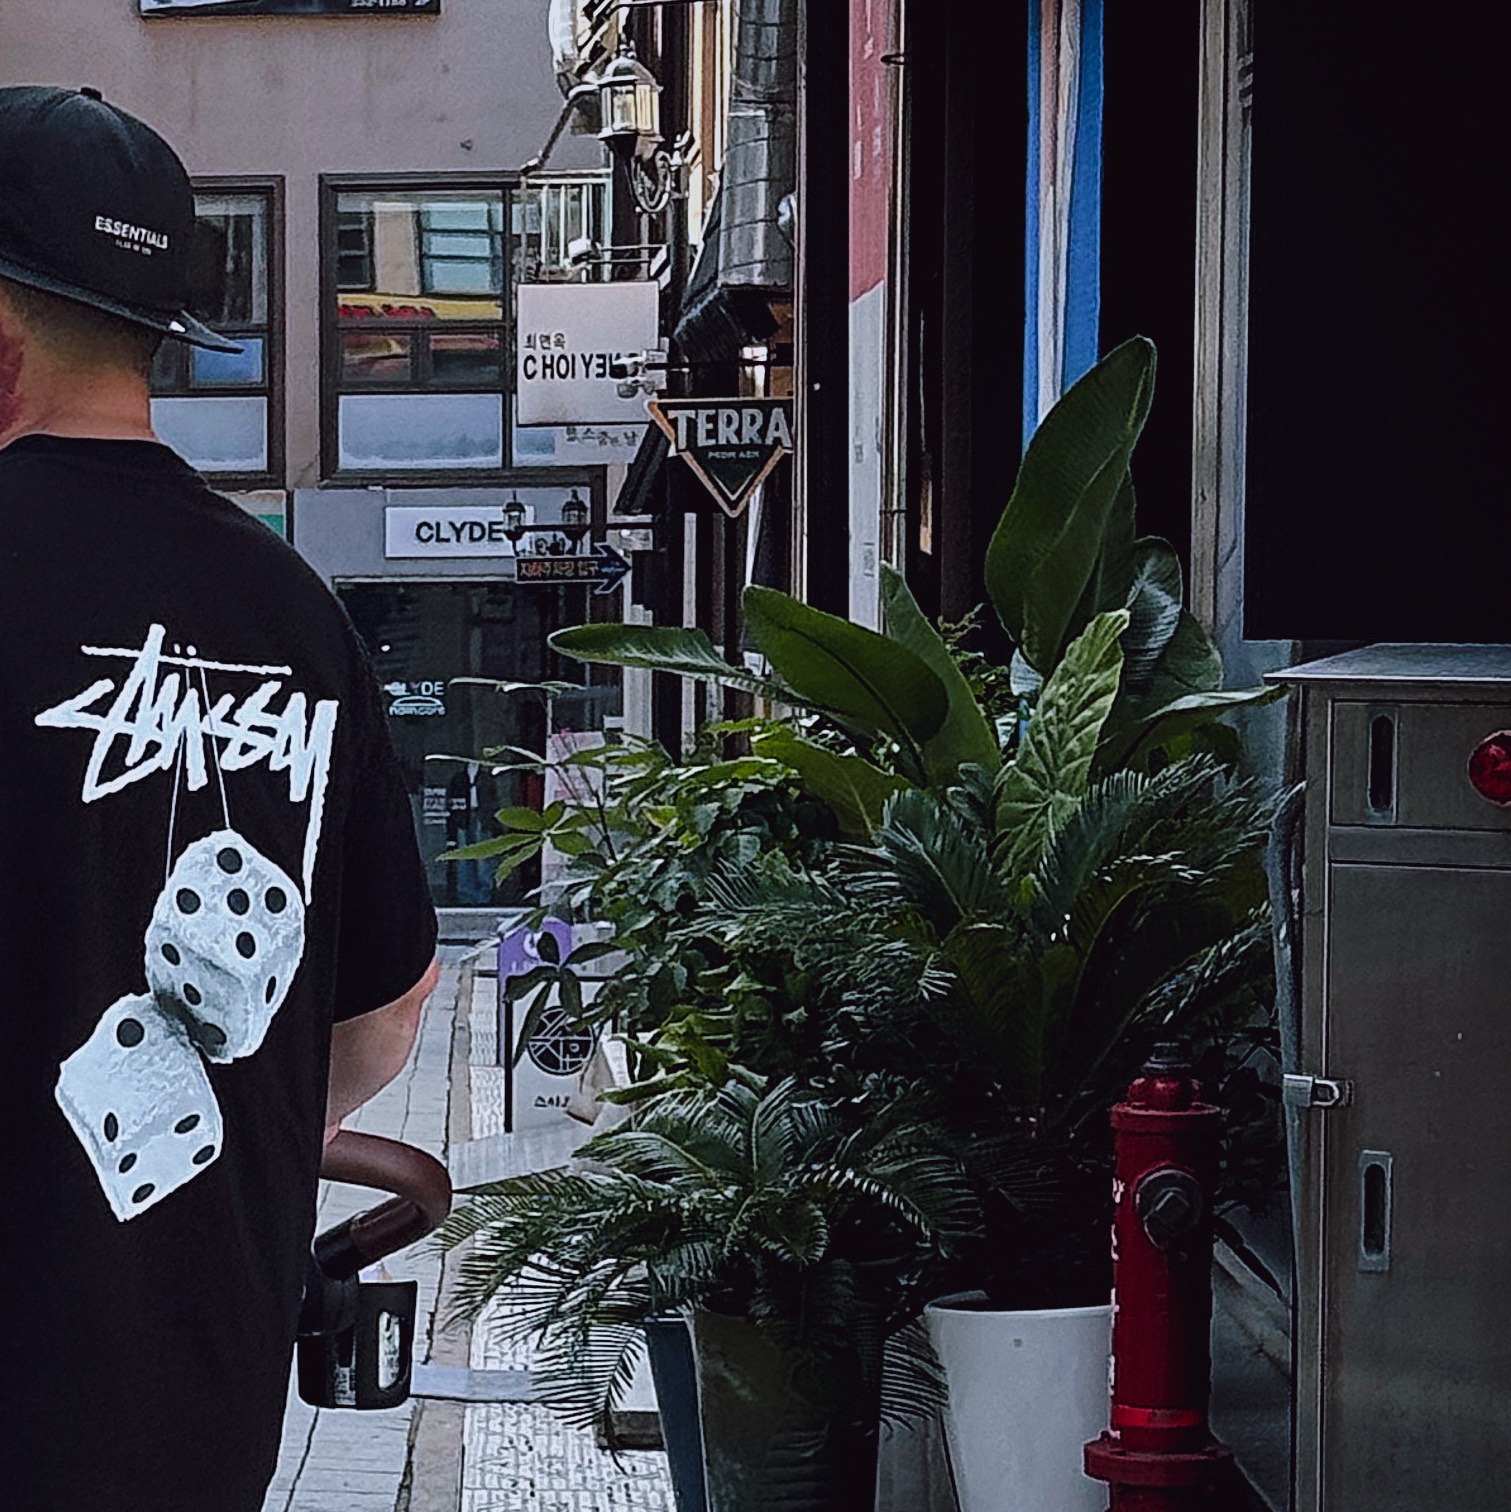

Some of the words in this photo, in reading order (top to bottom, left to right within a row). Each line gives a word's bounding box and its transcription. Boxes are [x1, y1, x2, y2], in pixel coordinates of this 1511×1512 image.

[523, 353, 576, 380] CHOI
[667, 407, 793, 450] TERRA
[415, 521, 505, 544] CLYDE
